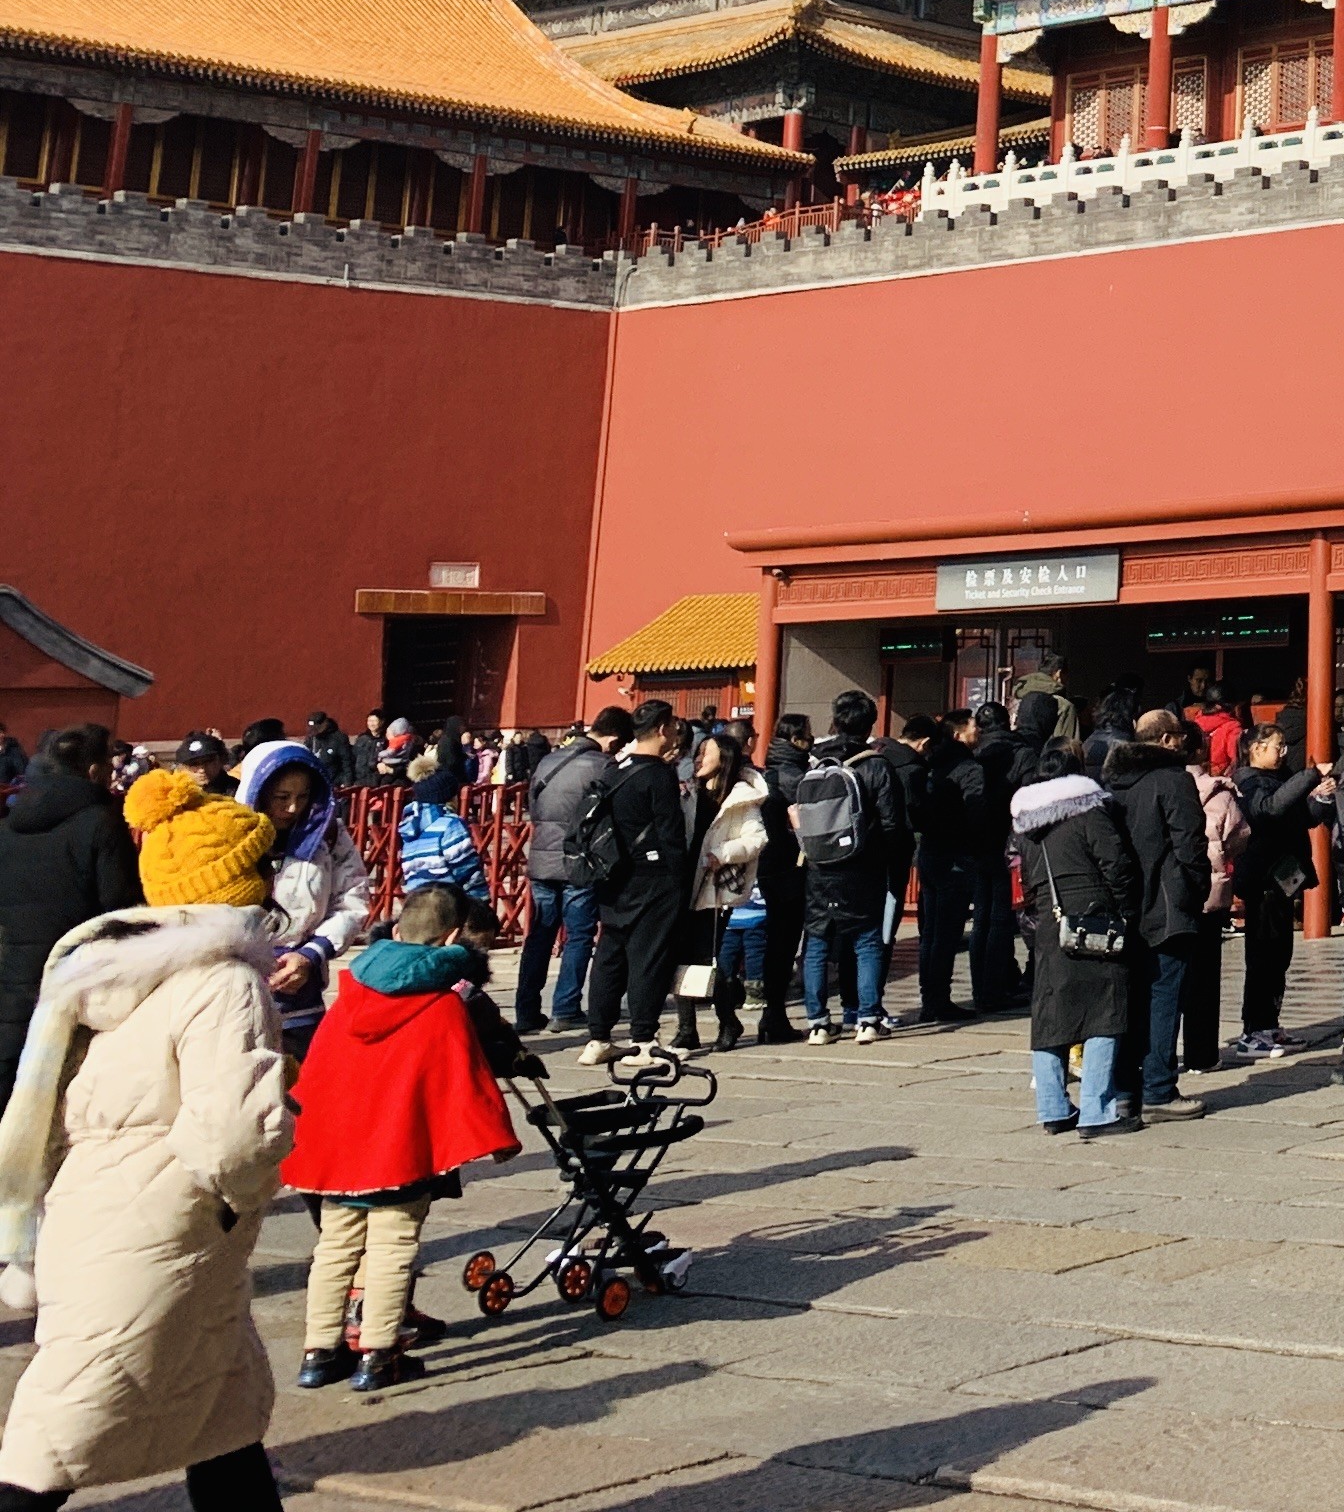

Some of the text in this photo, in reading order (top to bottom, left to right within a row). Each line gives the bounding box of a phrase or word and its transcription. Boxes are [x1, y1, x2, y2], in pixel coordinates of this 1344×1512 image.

[965, 565, 1086, 587] 检票及安检入口
[965, 584, 1086, 600] Ticket and Security Check Entrance
